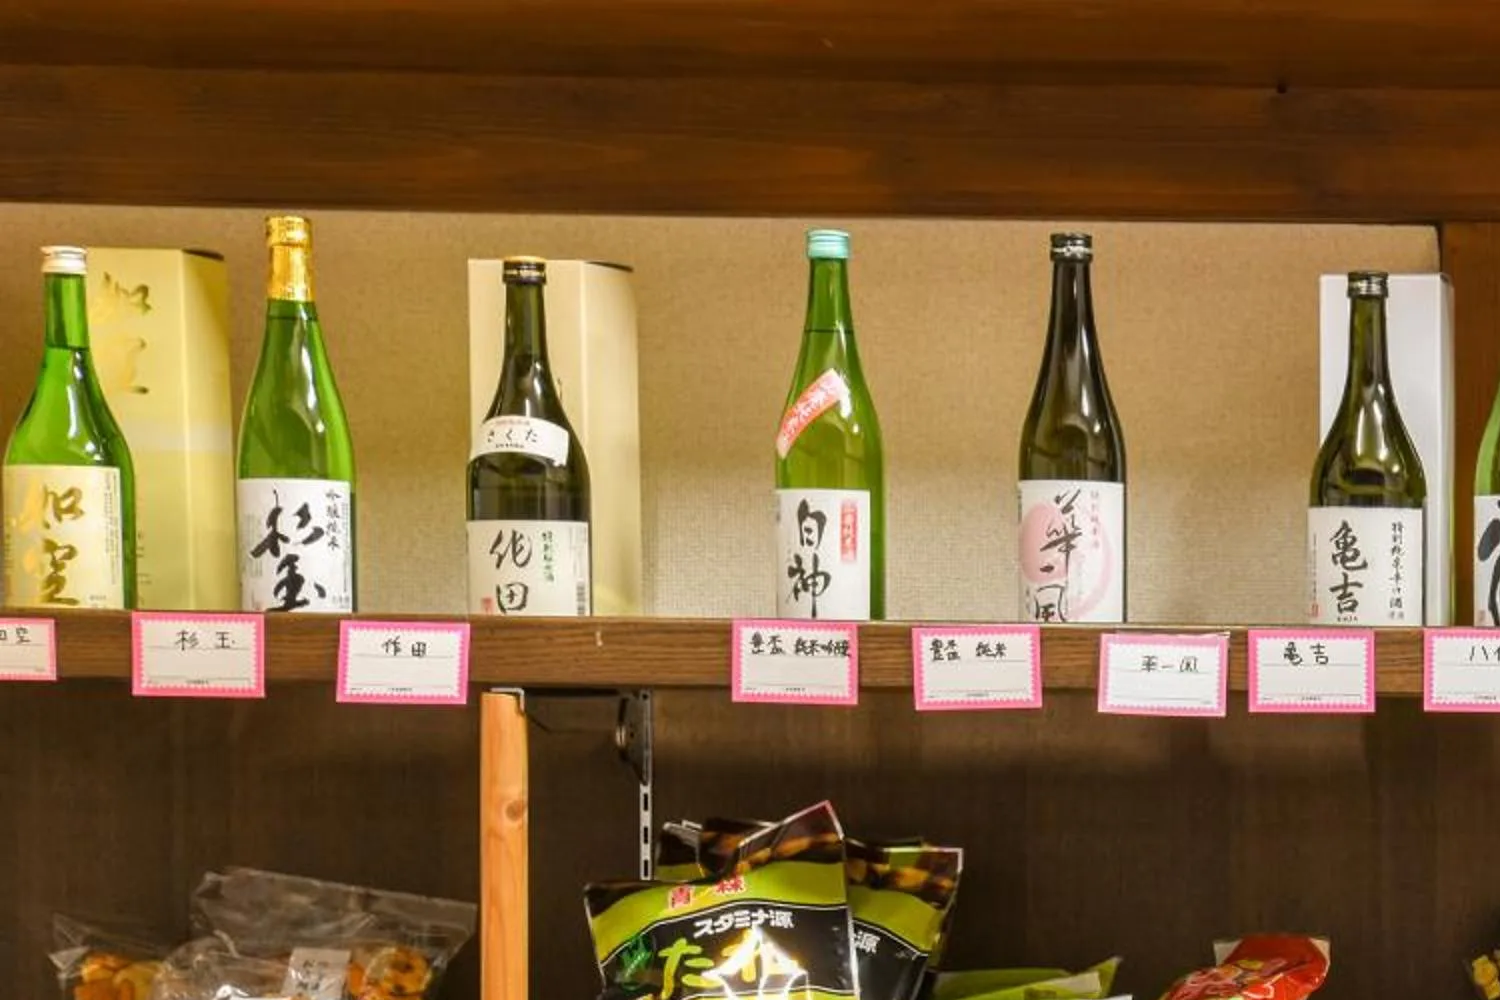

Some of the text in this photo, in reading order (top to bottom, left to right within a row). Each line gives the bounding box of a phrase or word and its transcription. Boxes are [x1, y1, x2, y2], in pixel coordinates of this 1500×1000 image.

[787, 499, 831, 619] 白神
[1329, 519, 1369, 614] 亀吉
[693, 908, 795, 939] スタミナ源
